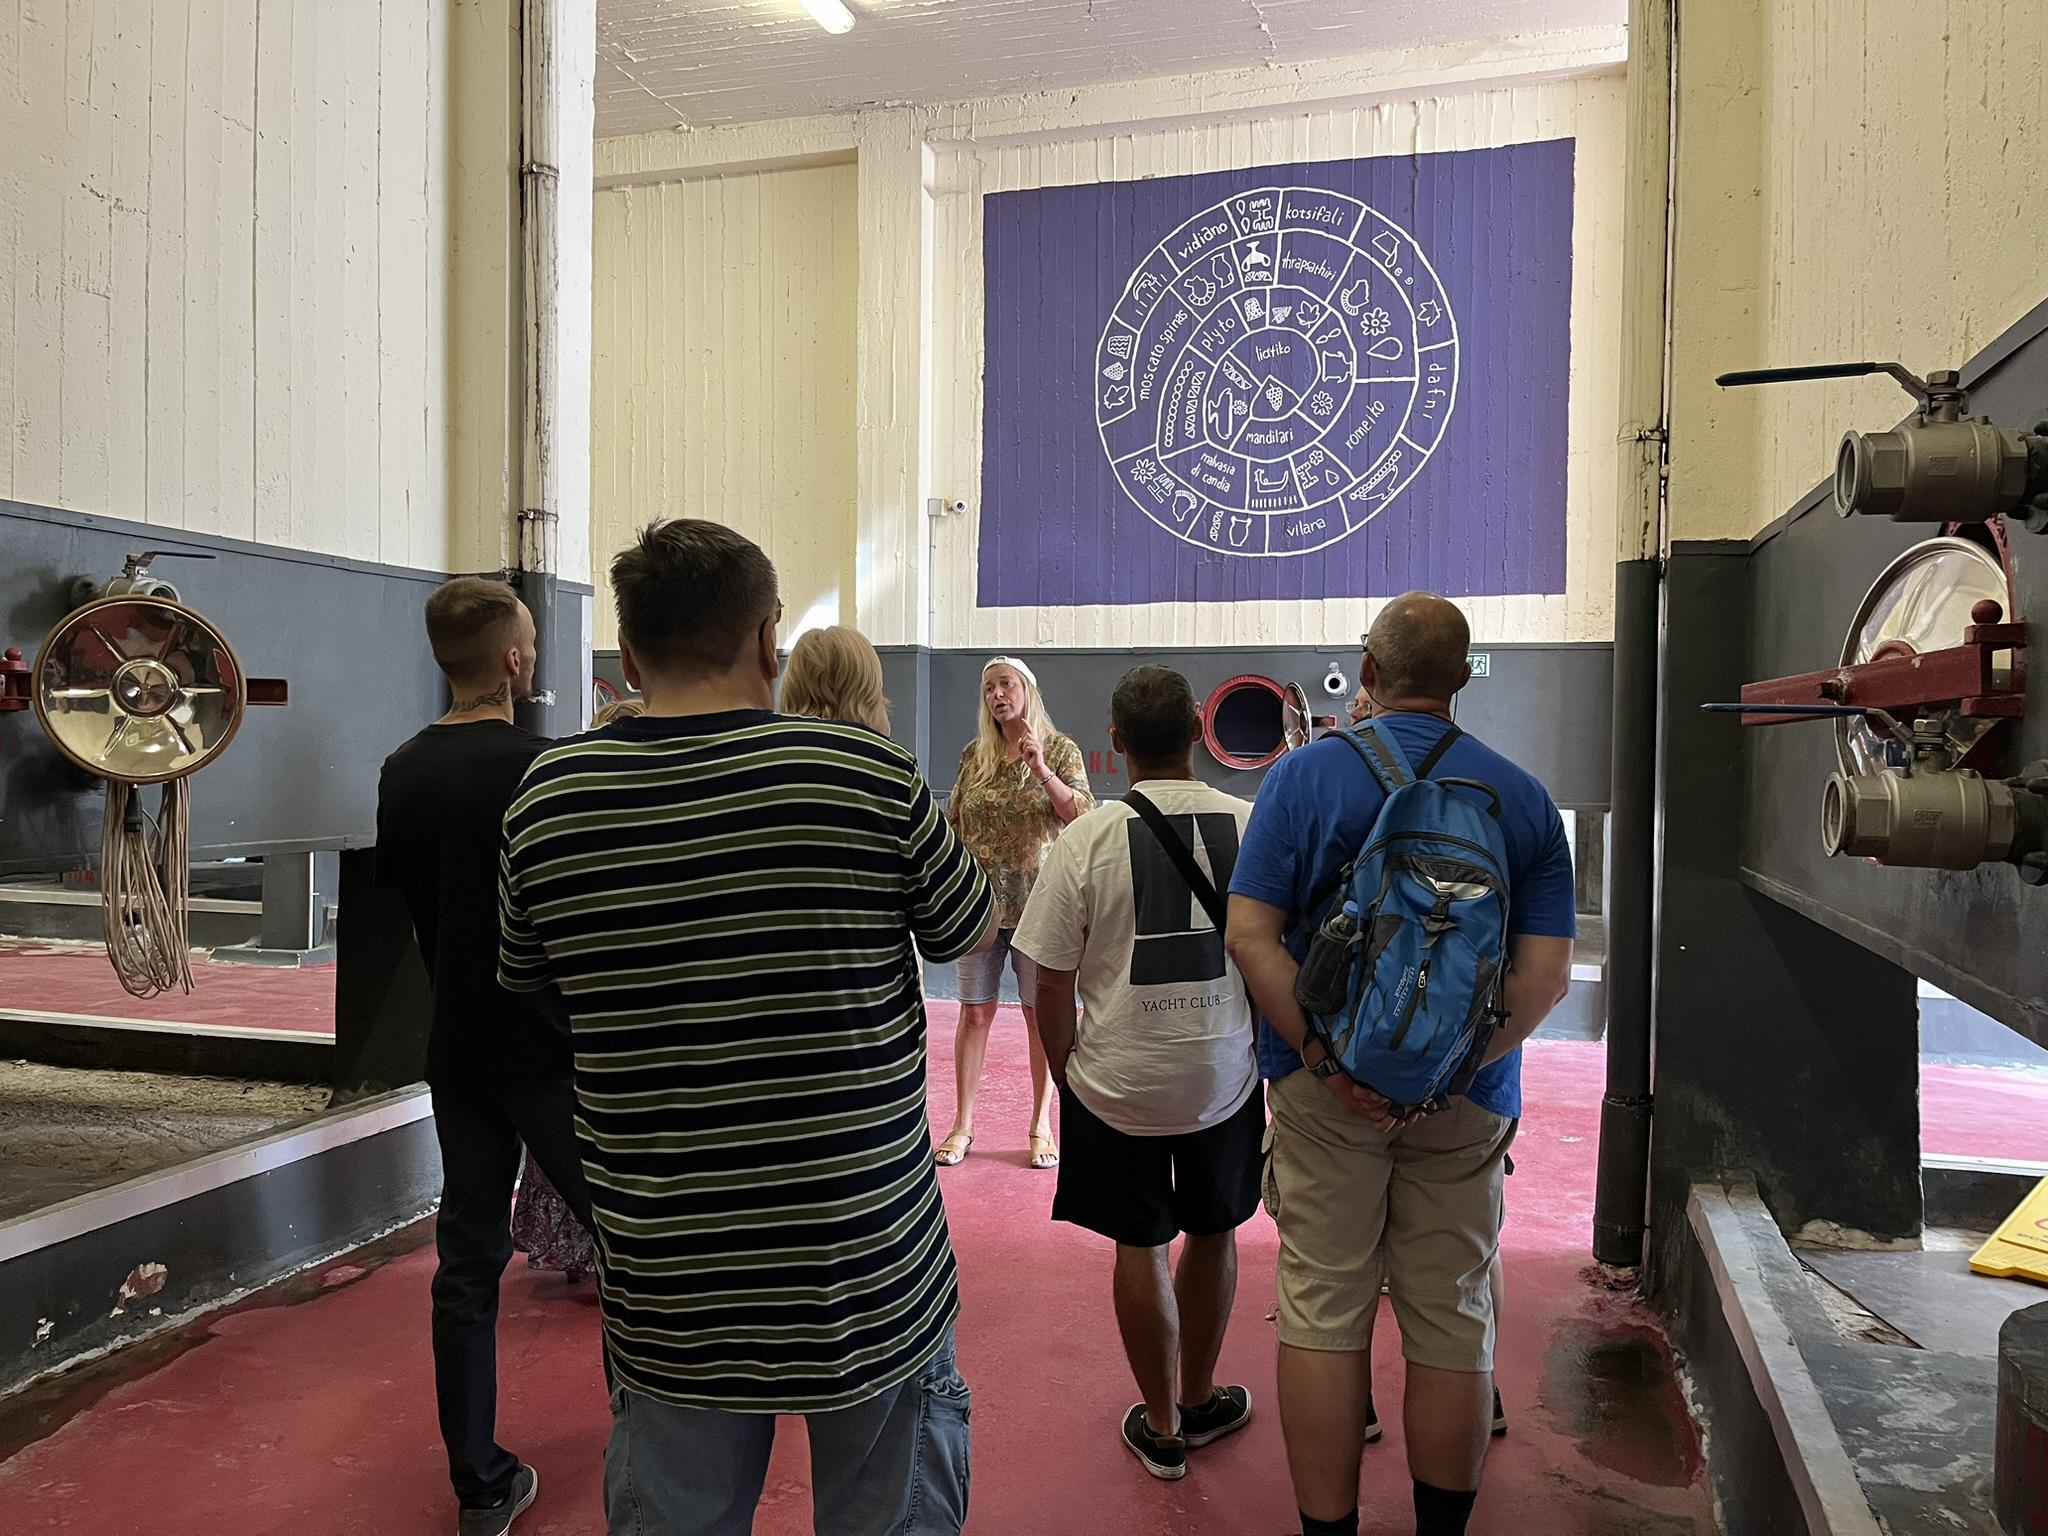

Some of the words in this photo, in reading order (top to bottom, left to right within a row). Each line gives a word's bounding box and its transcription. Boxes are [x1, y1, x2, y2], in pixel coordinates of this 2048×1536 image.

[1285, 202, 1345, 226] kotsifali
[1178, 221, 1228, 259] vidiano
[1201, 317, 1235, 352] plyto
[1140, 345, 1165, 400] moscato
[1159, 309, 1188, 344] spinas
[1255, 341, 1291, 362] liatiko
[1421, 363, 1447, 419] dafni
[1245, 428, 1294, 445] mandilari
[1344, 400, 1385, 450] romeiko
[1200, 452, 1236, 476] malvasia
[1190, 463, 1201, 477] di
[1202, 472, 1231, 493] candia
[1286, 518, 1326, 538] vilana
[1141, 998, 1186, 1012] YACHT
[1190, 994, 1221, 1008] CLUB
